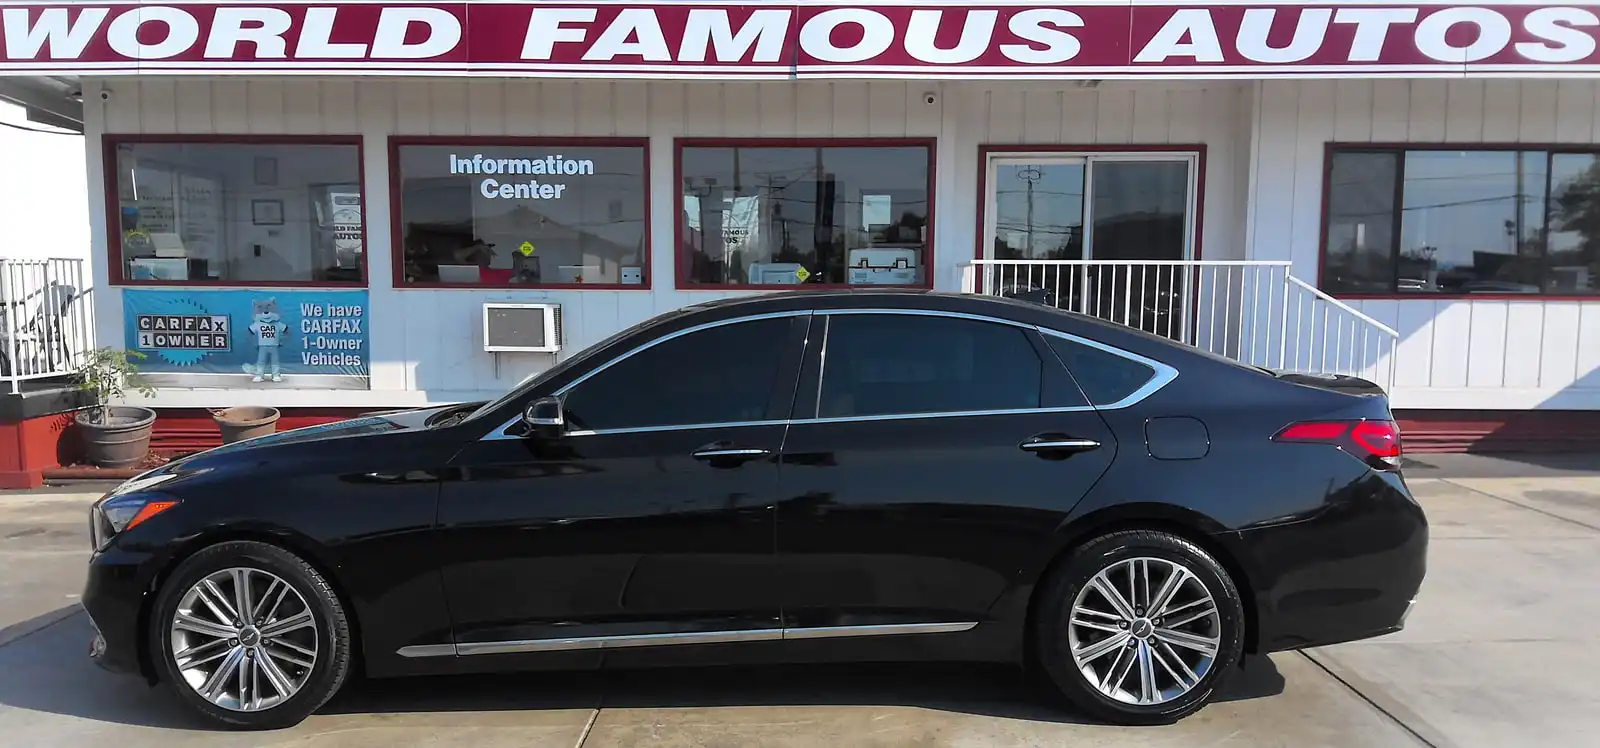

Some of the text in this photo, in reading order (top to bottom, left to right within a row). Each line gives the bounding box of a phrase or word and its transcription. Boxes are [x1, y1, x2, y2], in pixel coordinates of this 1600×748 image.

[1, 6, 1598, 64] WORLD FAMOUS AUTOS
[449, 153, 594, 175] Information
[480, 178, 566, 200] Center
[300, 302, 362, 317] We have
[140, 316, 224, 331] CARFAX
[300, 318, 362, 334] CARFAX
[261, 331, 276, 339] FOX
[301, 335, 363, 350] 1-Owner
[301, 351, 361, 366] Vehicles
